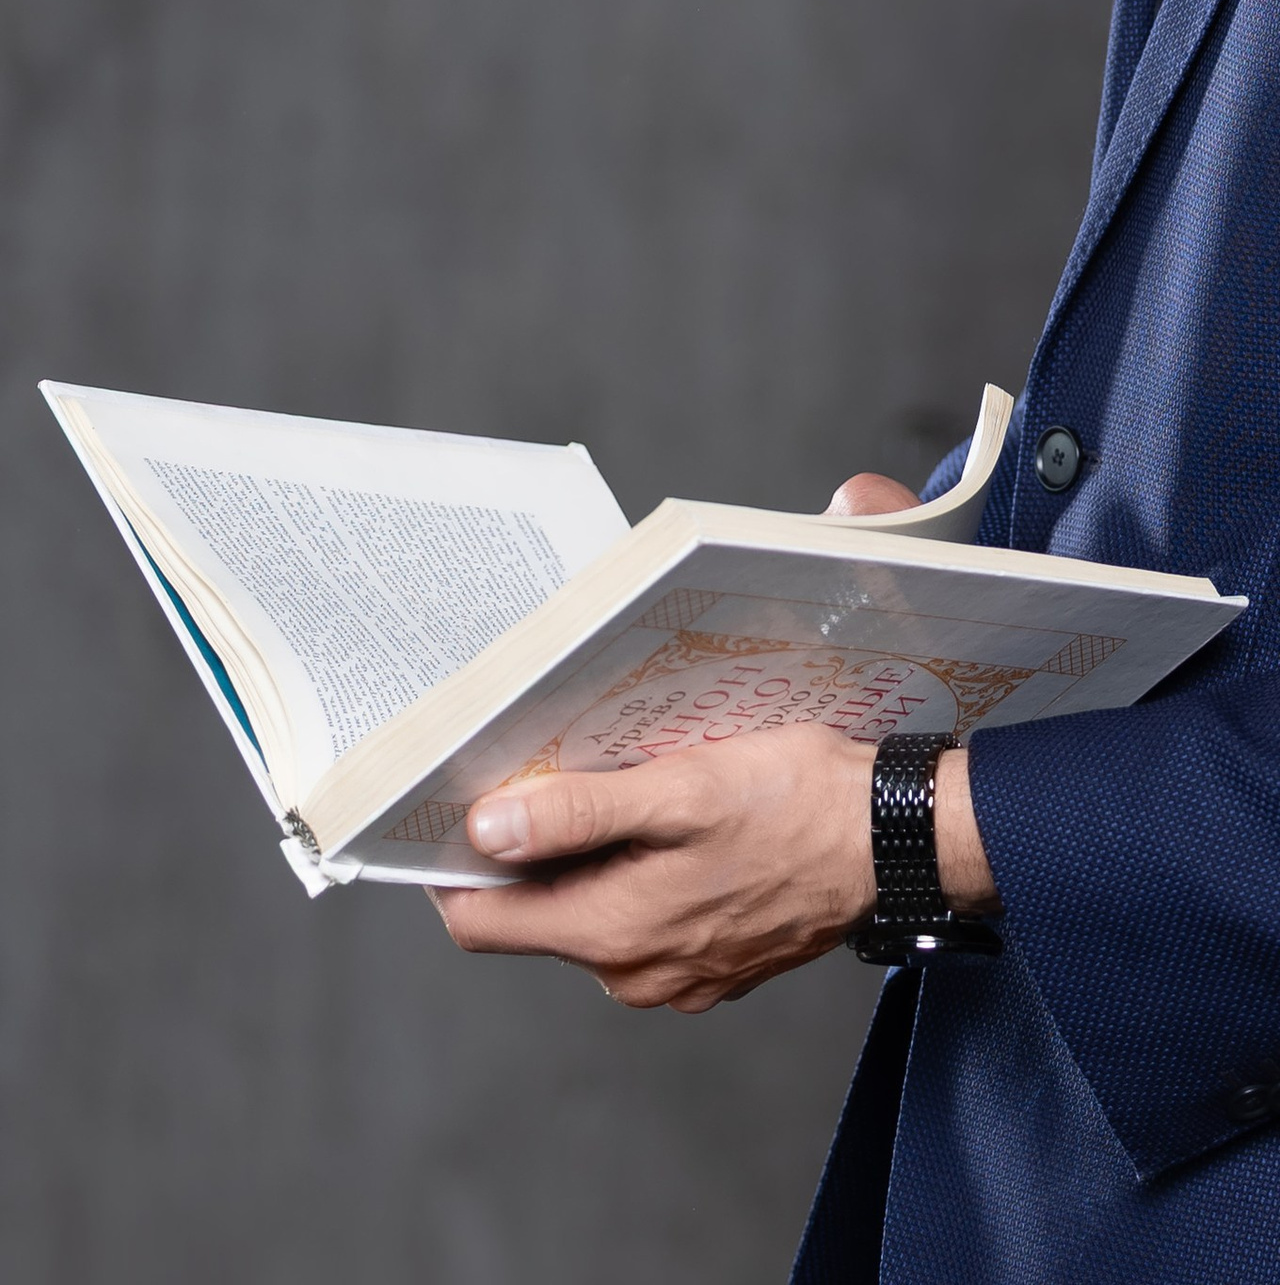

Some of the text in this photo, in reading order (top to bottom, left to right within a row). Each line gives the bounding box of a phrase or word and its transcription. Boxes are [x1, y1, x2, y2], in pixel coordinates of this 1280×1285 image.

[599, 690, 687, 758] ПРЕВО
[690, 677, 792, 746] СКО
[752, 690, 812, 731] РЛО
